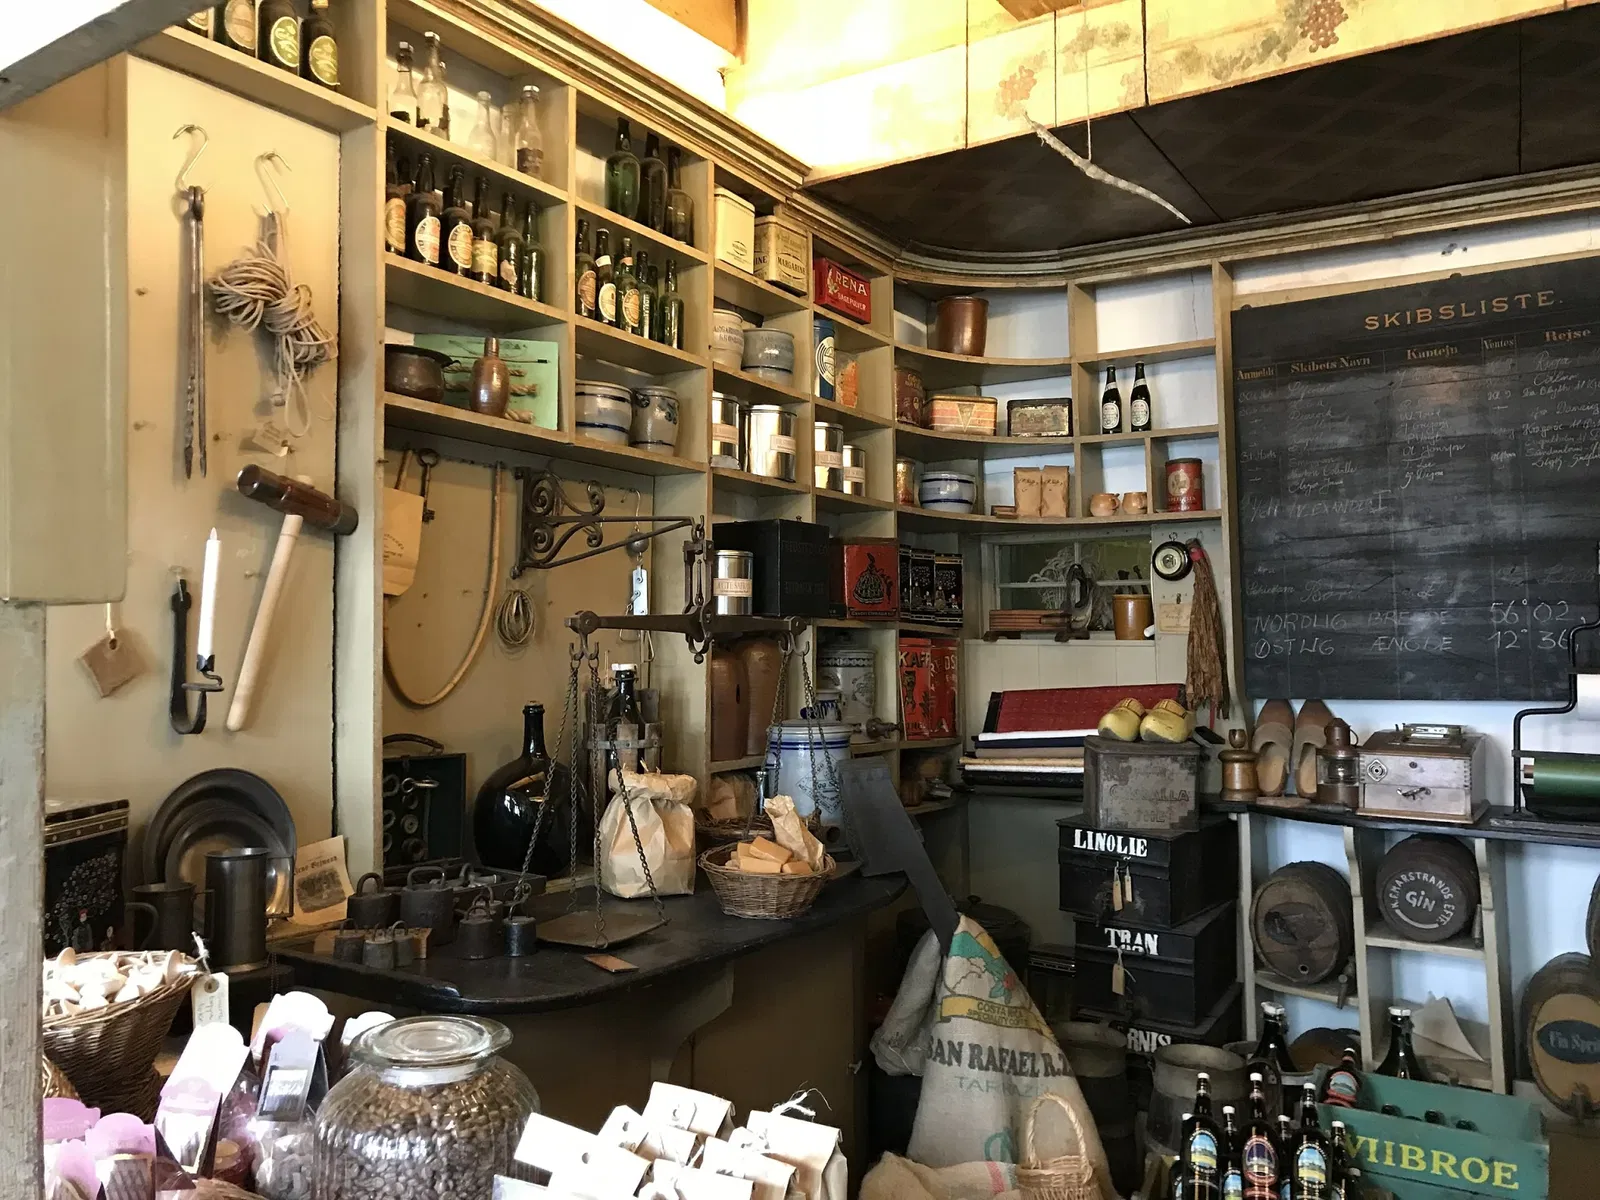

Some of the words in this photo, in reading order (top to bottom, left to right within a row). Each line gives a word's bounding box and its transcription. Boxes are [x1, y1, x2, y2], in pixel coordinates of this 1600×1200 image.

[835, 270, 868, 296] RENA
[1290, 359, 1338, 373] Skibets
[1339, 356, 1371, 368] Navn
[1544, 328, 1592, 342] Rejse
[1255, 612, 1346, 634] NORDLIG
[1367, 611, 1452, 626] BREDE
[1254, 638, 1335, 658] ØSTLIG
[1073, 829, 1148, 858] LINOLIE
[1104, 927, 1159, 956] TRAN
[977, 1001, 1006, 1017] COSTA
[1127, 1027, 1172, 1053] RNIS
[926, 1035, 963, 1067] SAN
[968, 1043, 1040, 1078] RAFAEL
